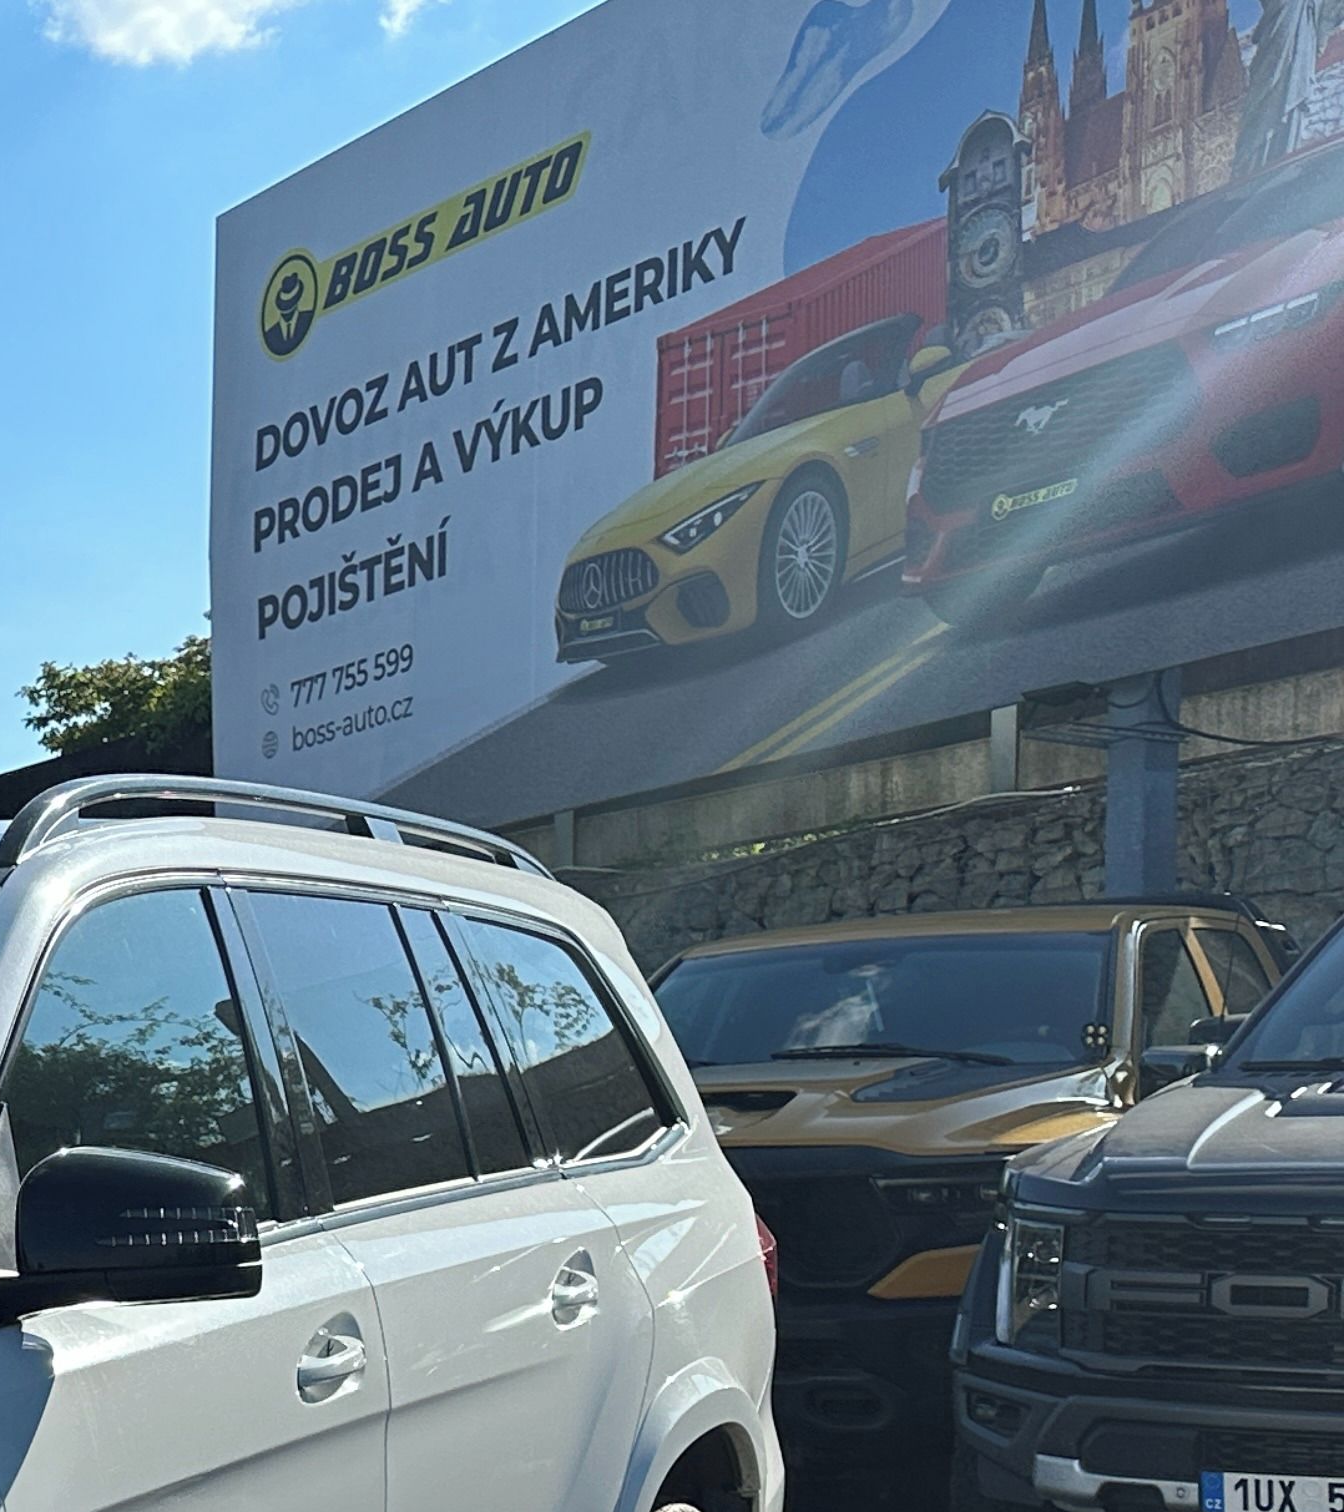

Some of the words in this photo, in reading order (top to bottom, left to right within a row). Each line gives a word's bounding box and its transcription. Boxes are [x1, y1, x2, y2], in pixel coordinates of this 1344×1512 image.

[322, 211, 437, 311] BOSS
[444, 141, 584, 253] AUTO
[254, 373, 390, 471] DOVOZ
[397, 332, 484, 411] AUT
[492, 316, 520, 373] Z
[527, 216, 747, 358] AMERIKY
[252, 457, 403, 553] PRODEJ
[413, 441, 443, 493] A
[452, 375, 605, 473] VÝKUP
[257, 515, 452, 640] POJIŠTĚNÍ
[290, 670, 328, 708] 777
[332, 656, 369, 694] 755
[373, 642, 415, 680] 599
[290, 695, 415, 753] boss-auto.cz
[1205, 1499, 1222, 1510] CZ
